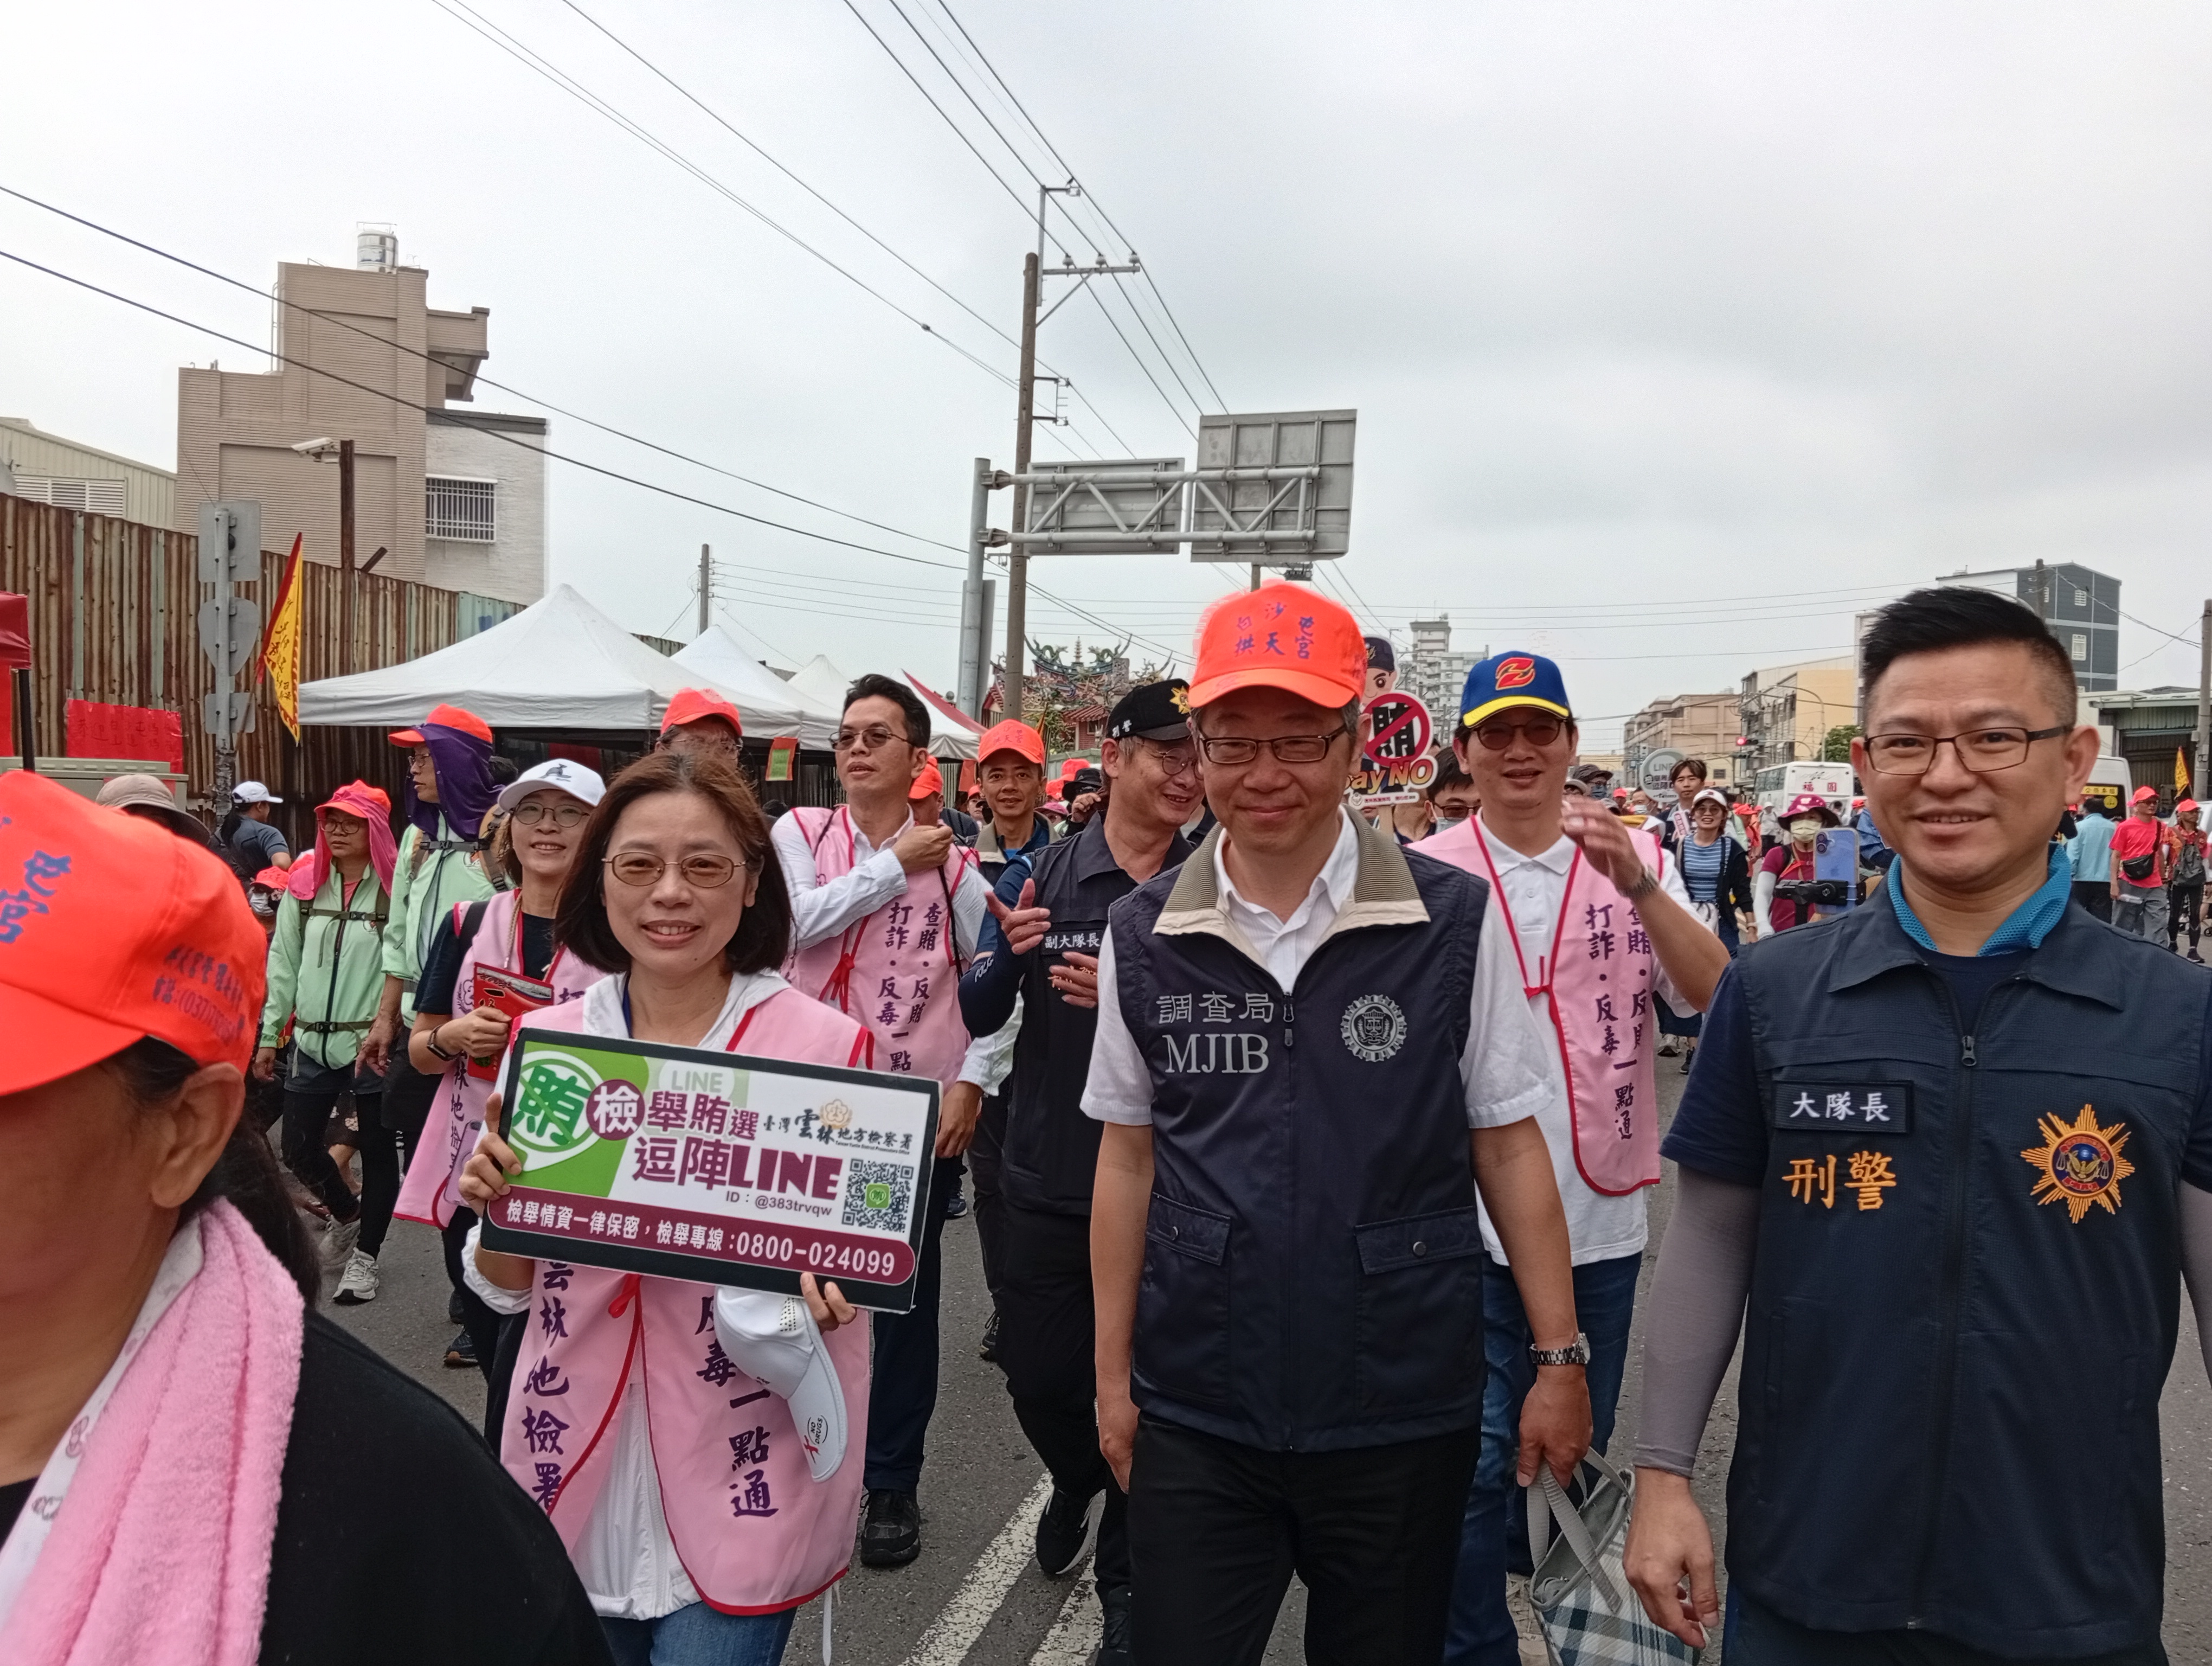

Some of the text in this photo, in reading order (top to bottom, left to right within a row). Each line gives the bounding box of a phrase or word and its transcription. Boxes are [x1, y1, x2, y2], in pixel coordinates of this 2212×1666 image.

[1234, 631, 1315, 660] 拱天宮
[1348, 759, 1434, 794] ay NO
[1044, 932, 1101, 949] 副大隊長
[1156, 991, 1275, 1024] 調查局
[1162, 1033, 1269, 1074] MJIB
[671, 1071, 723, 1093] LINE
[512, 1065, 592, 1146] 賄
[593, 1085, 759, 1140] 檢舉賄選
[1790, 1091, 1891, 1122] 大隊長
[632, 1136, 843, 1201] 逗陣LINE
[1782, 1151, 1897, 1211] 刑警
[810, 1421, 816, 1434] NO
[815, 1418, 823, 1444] DRUGS
